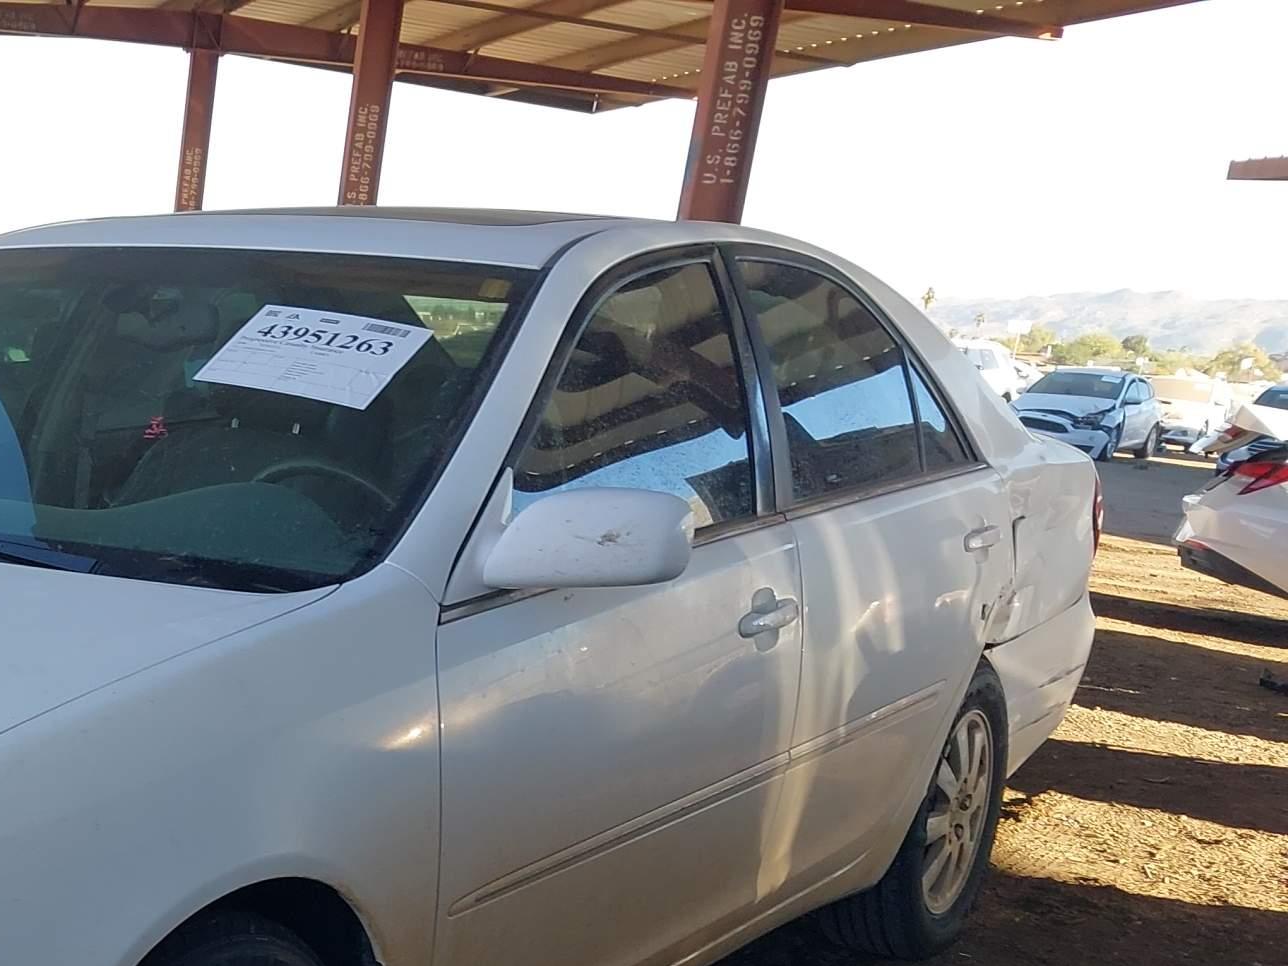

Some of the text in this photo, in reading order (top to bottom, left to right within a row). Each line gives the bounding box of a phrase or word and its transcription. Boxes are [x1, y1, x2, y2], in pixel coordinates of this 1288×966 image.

[701, 13, 748, 184] U.S. PREFAB INC.
[720, 15, 764, 183] 1-866-799-0969
[257, 323, 394, 356] 43951263
